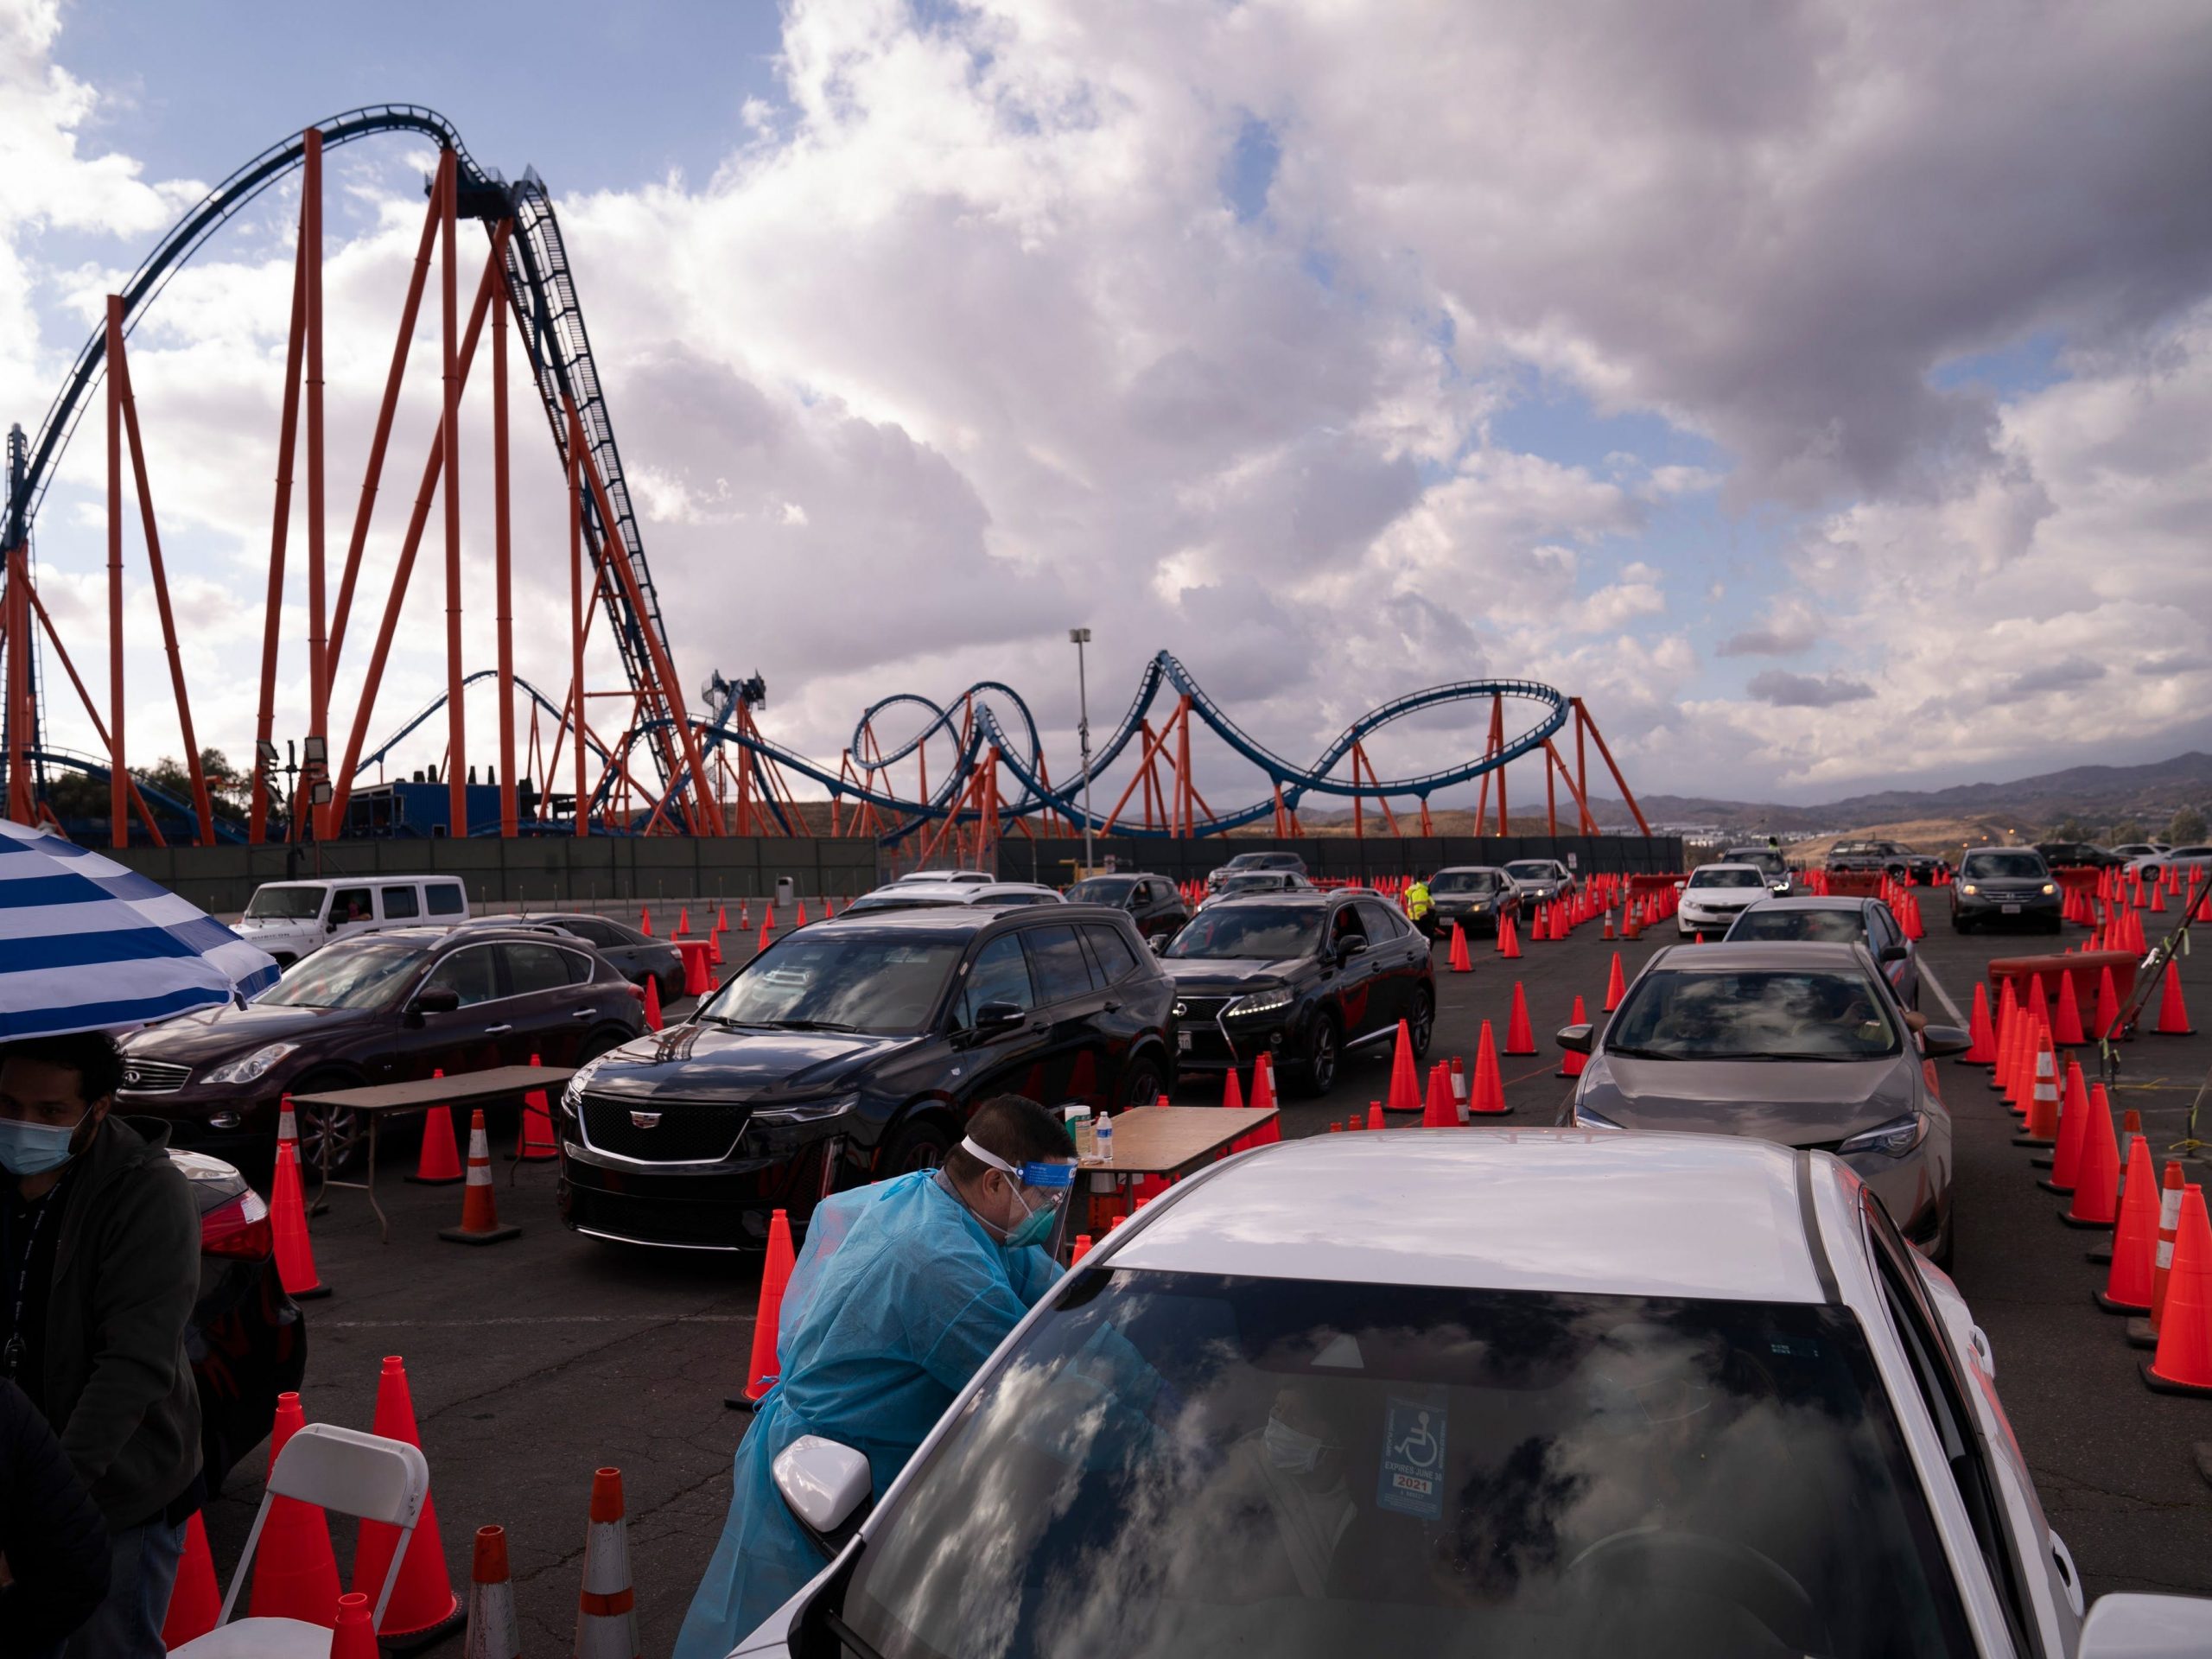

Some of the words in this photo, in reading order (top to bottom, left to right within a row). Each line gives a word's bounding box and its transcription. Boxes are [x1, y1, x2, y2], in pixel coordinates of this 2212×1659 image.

[1385, 1461, 1414, 1475] EXPIRES
[1415, 1468, 1433, 1479] JUNE
[1433, 1471, 1442, 1482] 30
[1398, 1476, 1427, 1491] 2021
